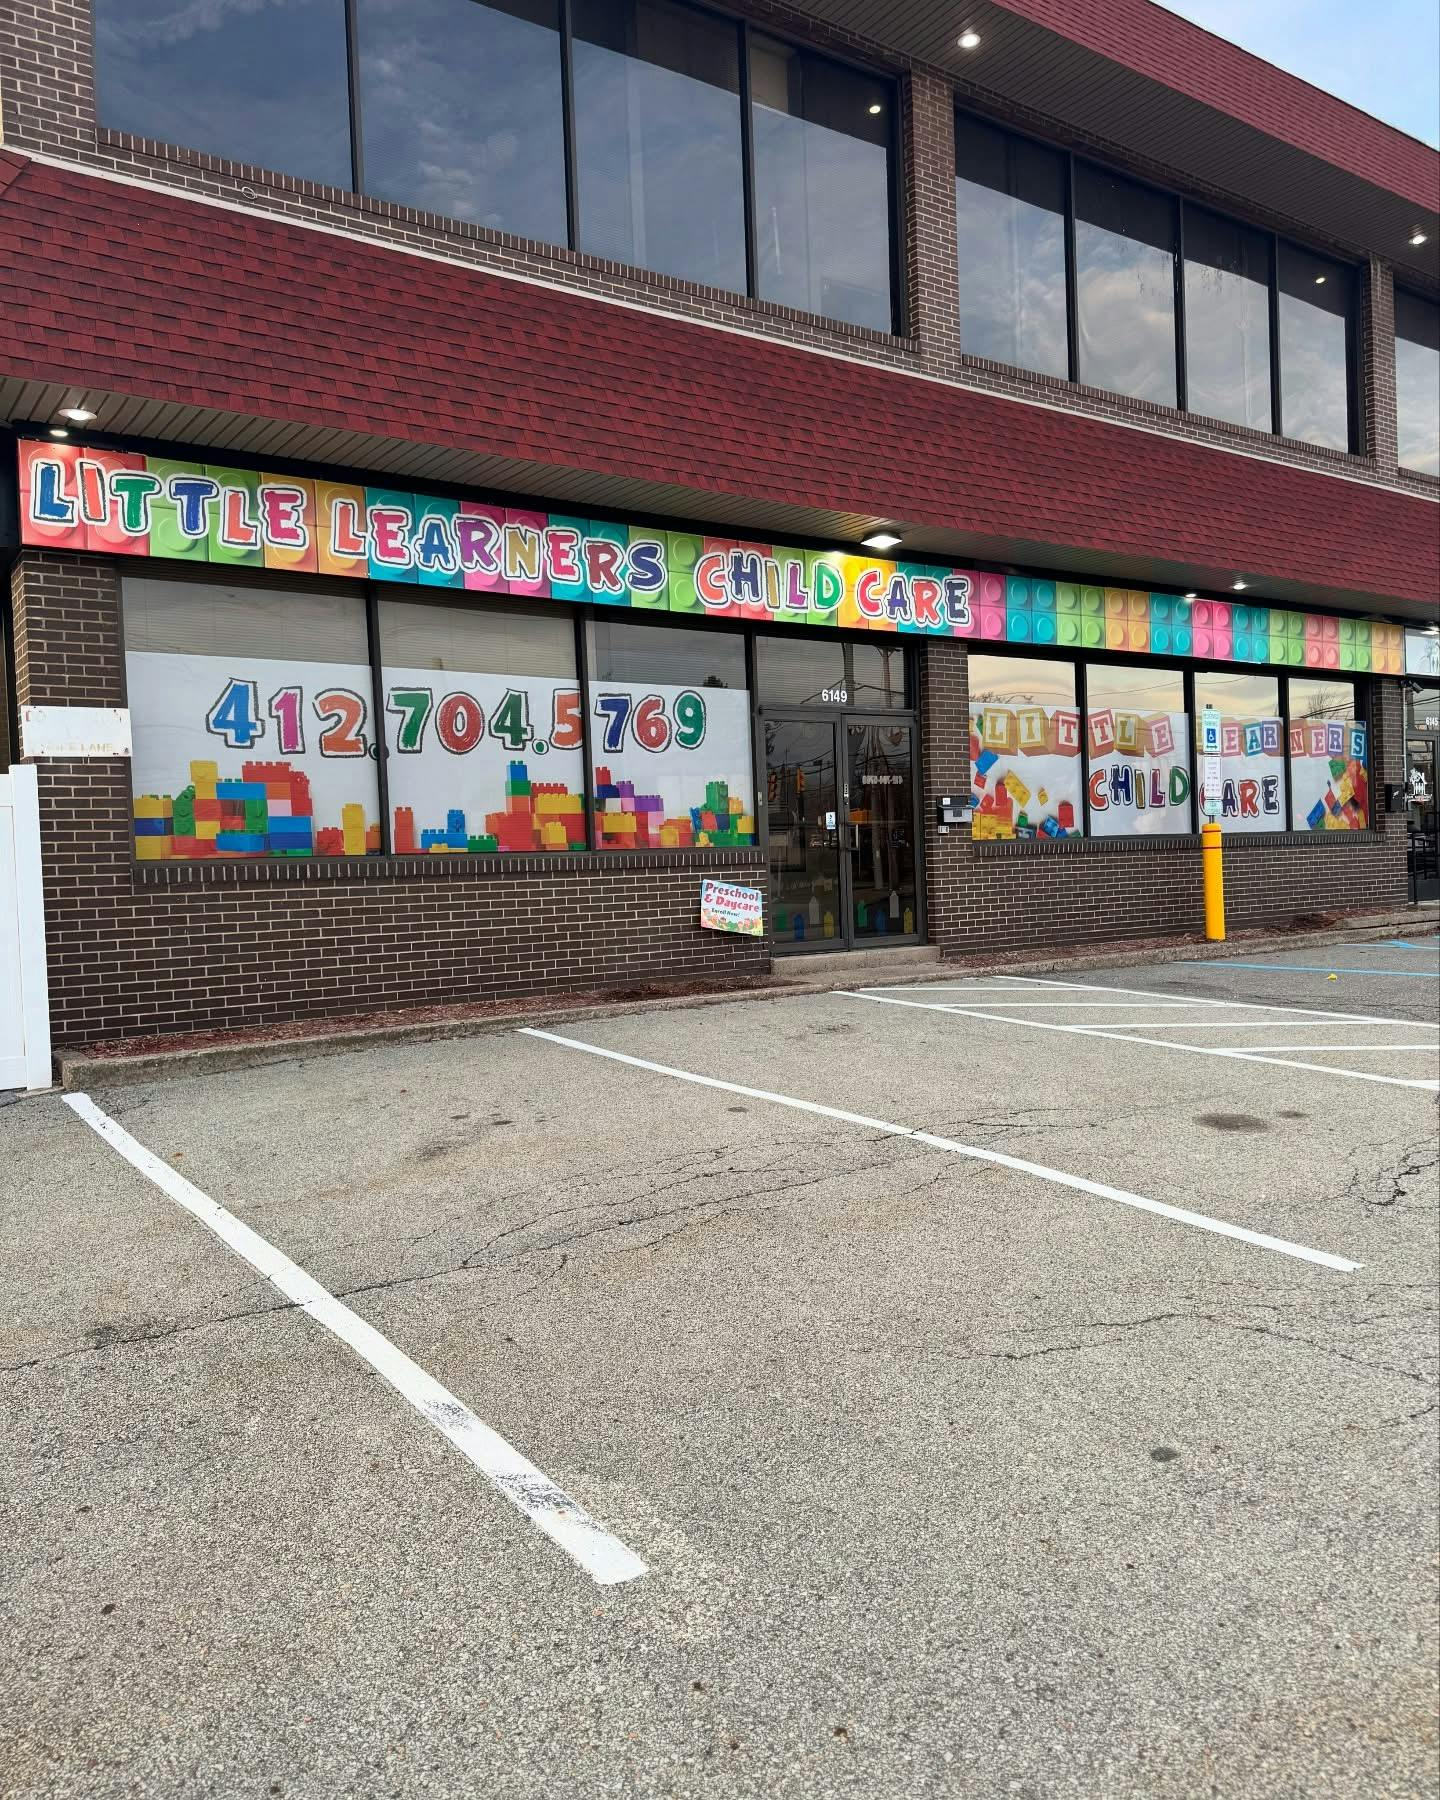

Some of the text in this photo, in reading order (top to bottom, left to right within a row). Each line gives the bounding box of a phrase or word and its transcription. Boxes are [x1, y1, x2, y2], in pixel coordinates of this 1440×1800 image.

[32, 460, 972, 627] LITTLE LEARNERS CHILD CARE
[821, 688, 848, 703] 6149
[984, 711, 1367, 758] LITTLE EARNERS
[1088, 764, 1191, 811] CHILD
[1199, 775, 1280, 818] ARE
[704, 893, 759, 912] & Daycare
[705, 882, 758, 901] Preschool
